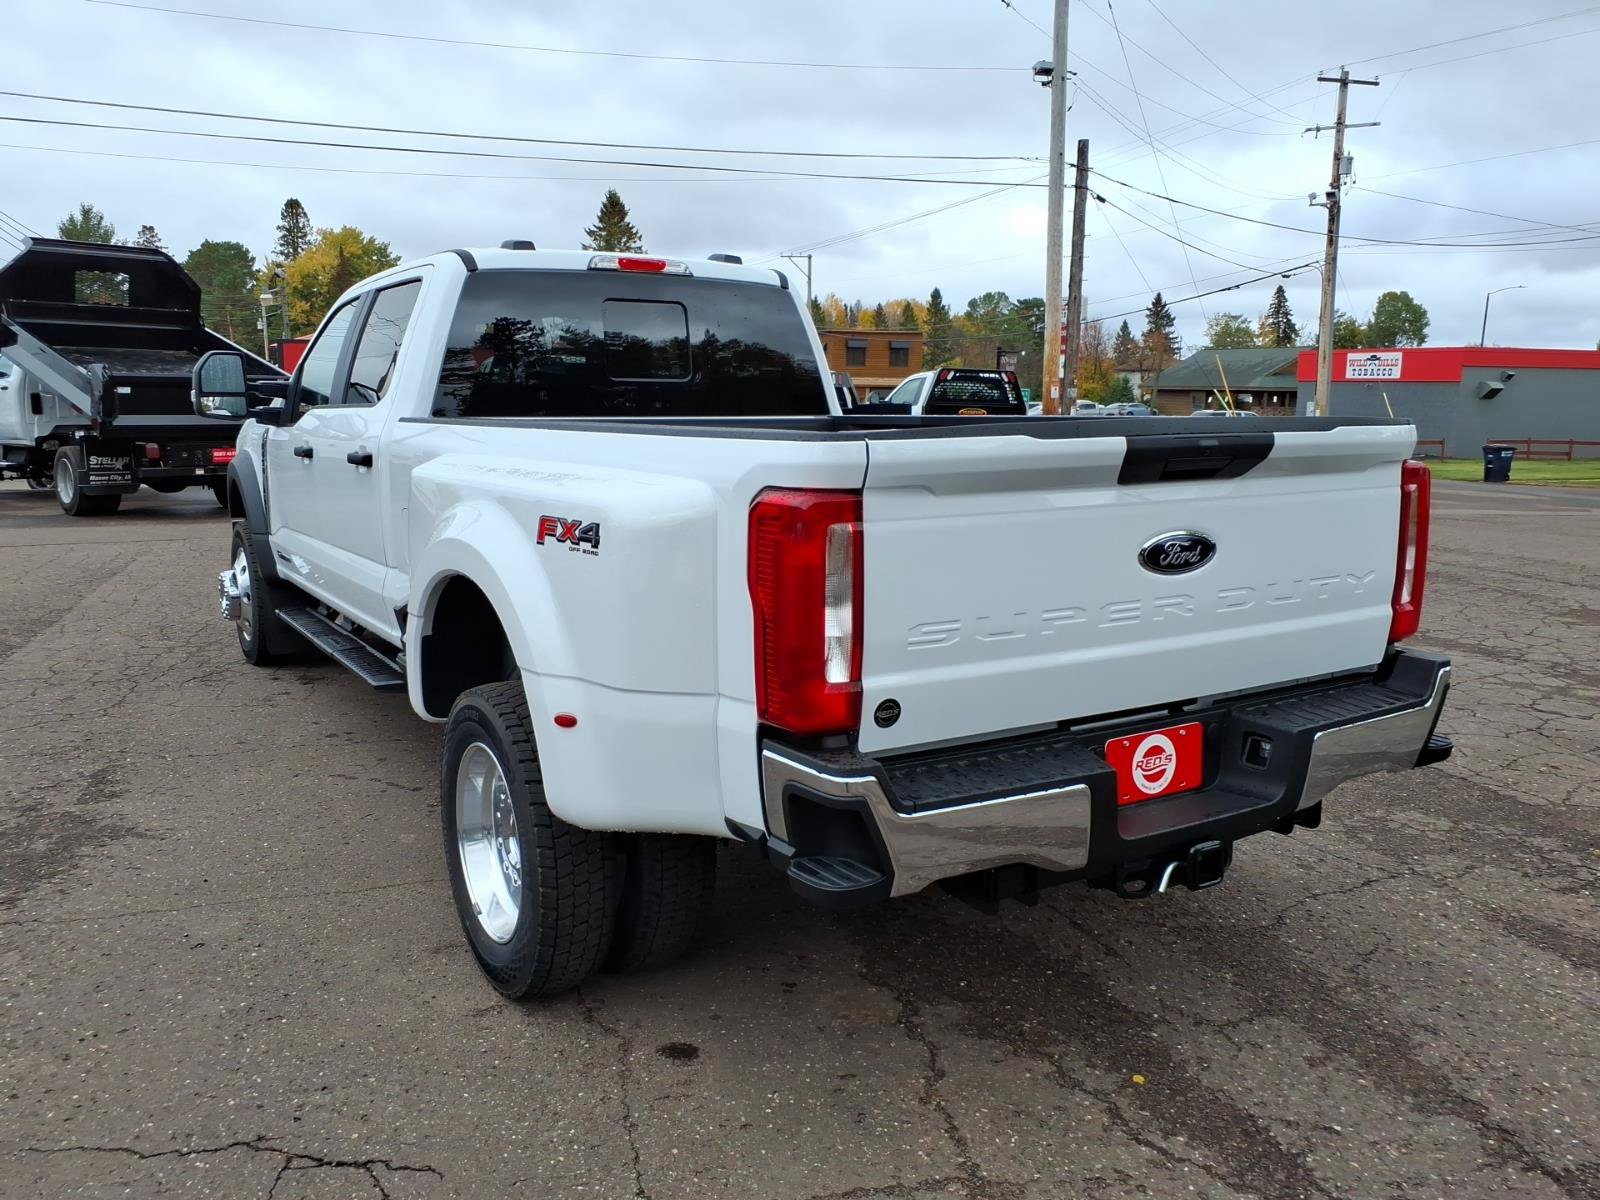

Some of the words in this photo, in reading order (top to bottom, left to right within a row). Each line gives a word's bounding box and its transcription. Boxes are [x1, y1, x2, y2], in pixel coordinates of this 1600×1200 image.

[1349, 359, 1368, 367] WILD
[1352, 368, 1393, 376] TOBACCO
[536, 514, 601, 549] FX4
[582, 548, 599, 556] ROAD
[1160, 541, 1202, 566] Ford
[907, 594, 1195, 650] SUPER
[1216, 569, 1377, 612] DUTY
[1135, 754, 1173, 771] RED'S
